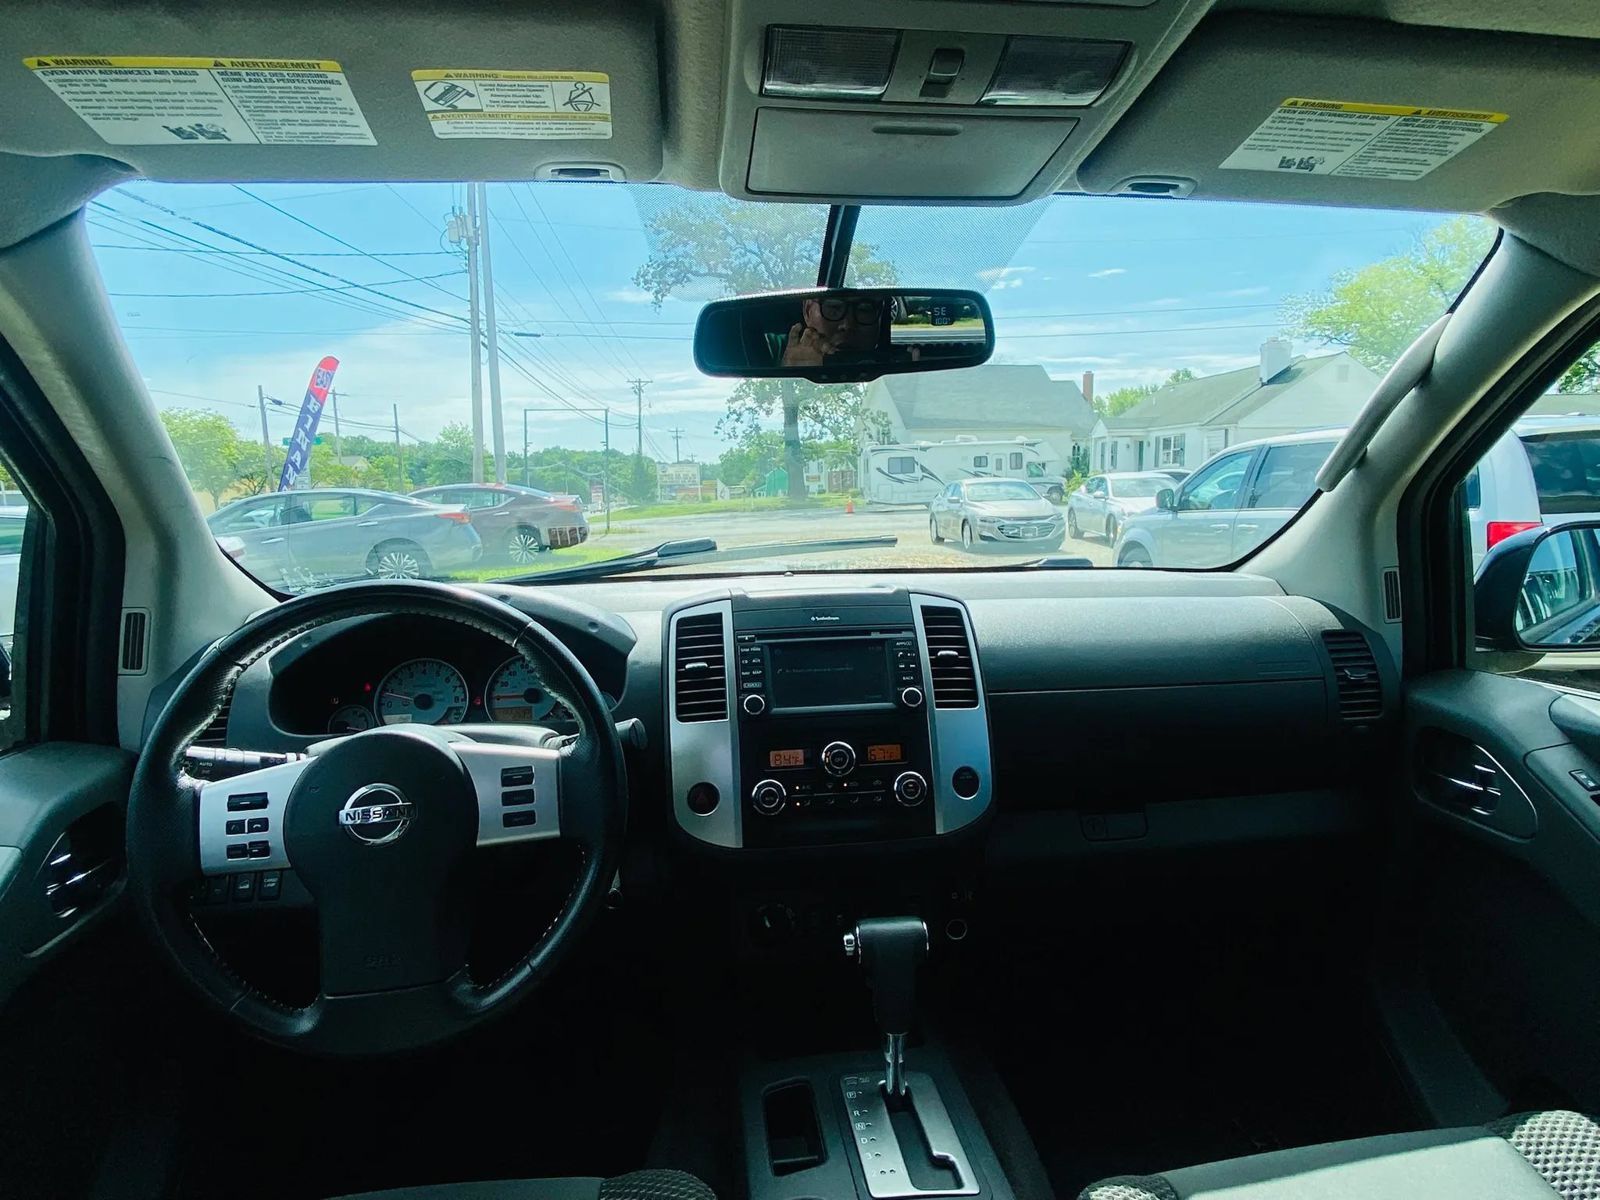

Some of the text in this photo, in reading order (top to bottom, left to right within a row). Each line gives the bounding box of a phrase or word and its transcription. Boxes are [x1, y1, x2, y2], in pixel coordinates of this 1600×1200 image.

[50, 58, 113, 66] WARNING
[229, 60, 322, 70] AVERTISSEMENT
[933, 306, 947, 316] SE
[344, 806, 408, 821] NISSAN
